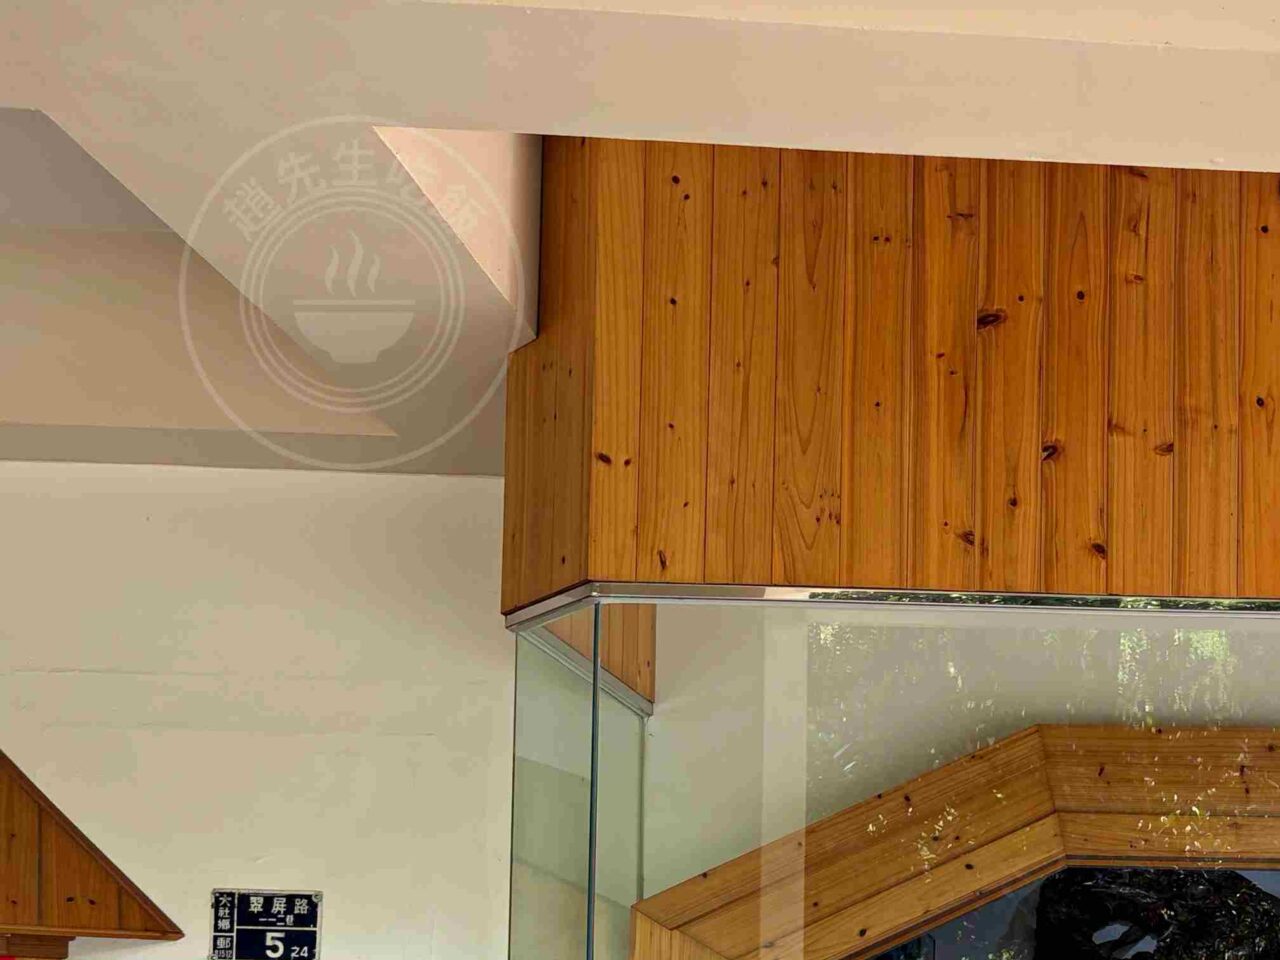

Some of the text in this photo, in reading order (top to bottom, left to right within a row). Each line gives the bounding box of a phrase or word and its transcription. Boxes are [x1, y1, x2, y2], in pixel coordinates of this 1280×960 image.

[248, 896, 309, 914] 翠屏路
[259, 914, 295, 926] 一一二巷
